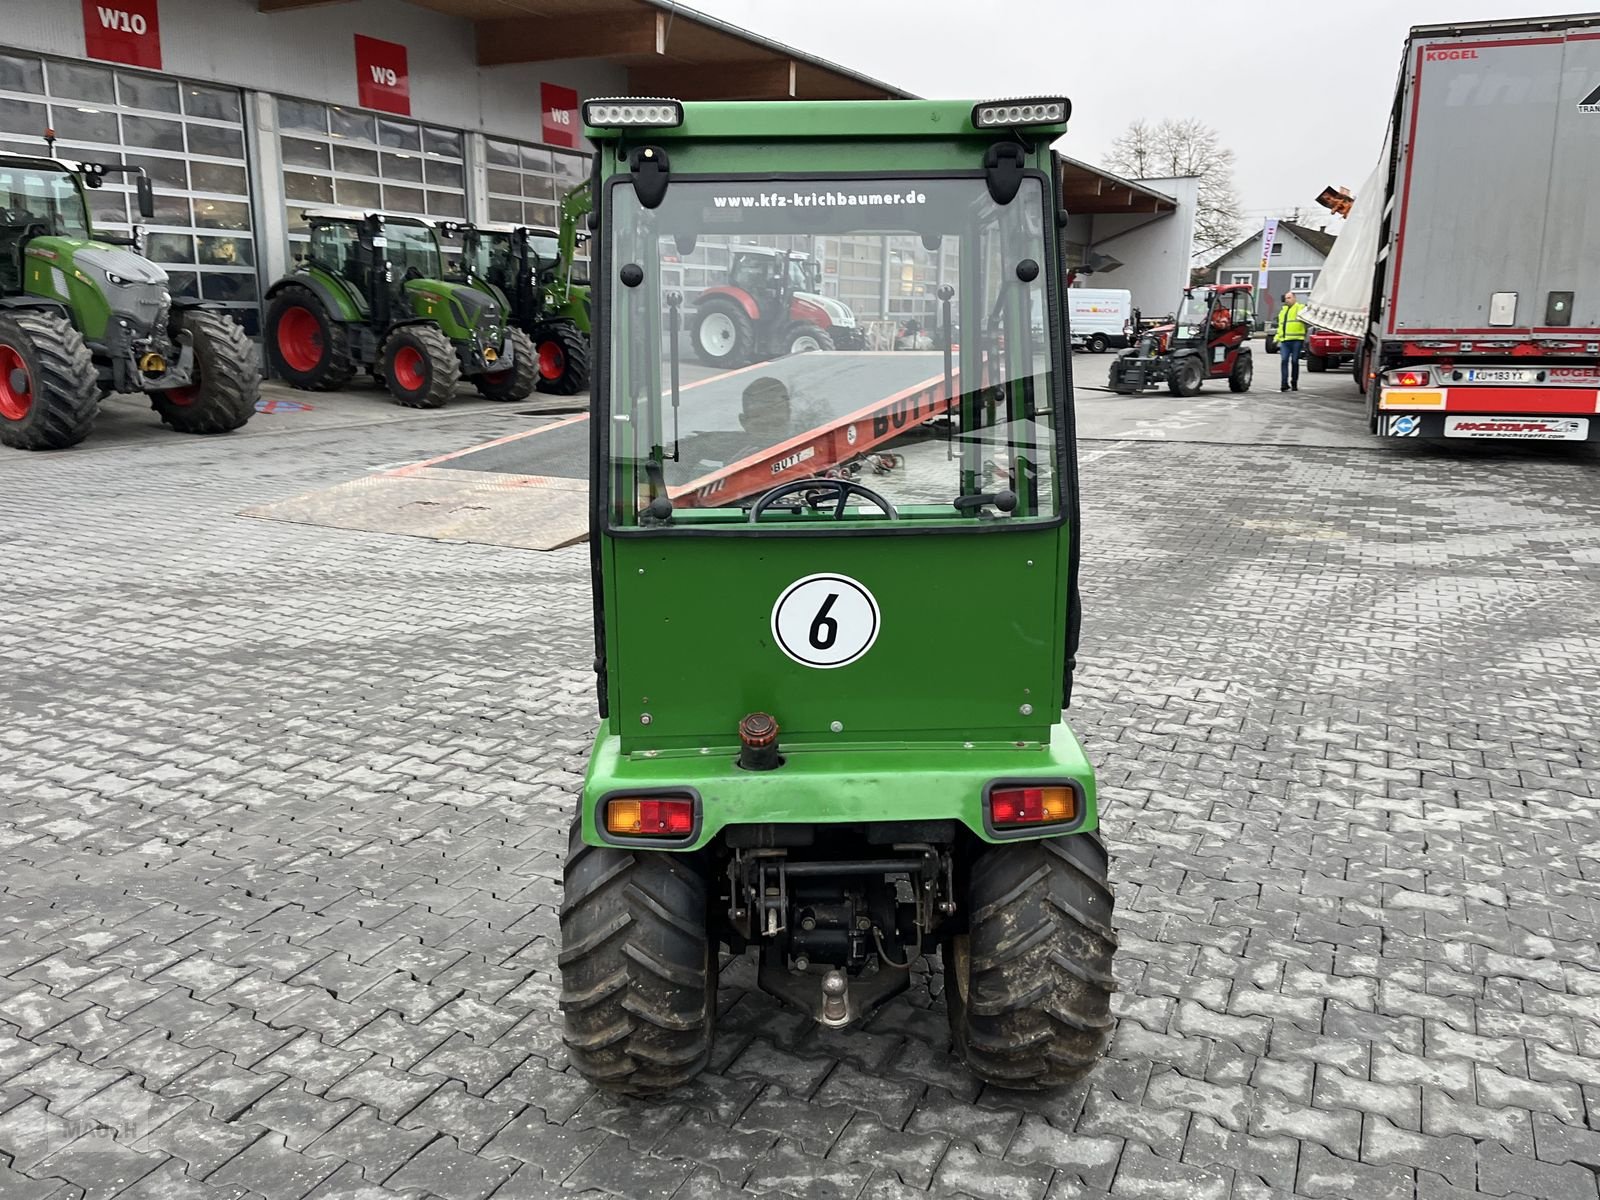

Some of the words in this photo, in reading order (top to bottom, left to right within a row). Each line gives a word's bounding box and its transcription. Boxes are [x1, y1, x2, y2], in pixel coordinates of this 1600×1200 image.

[97, 6, 147, 35] W10
[370, 65, 397, 86] W9
[551, 107, 570, 125] W8
[713, 190, 926, 207] www.kfz-krichbaumer.de
[873, 388, 938, 439] BUTT
[773, 452, 801, 472] BUTT
[808, 593, 840, 650] 6
